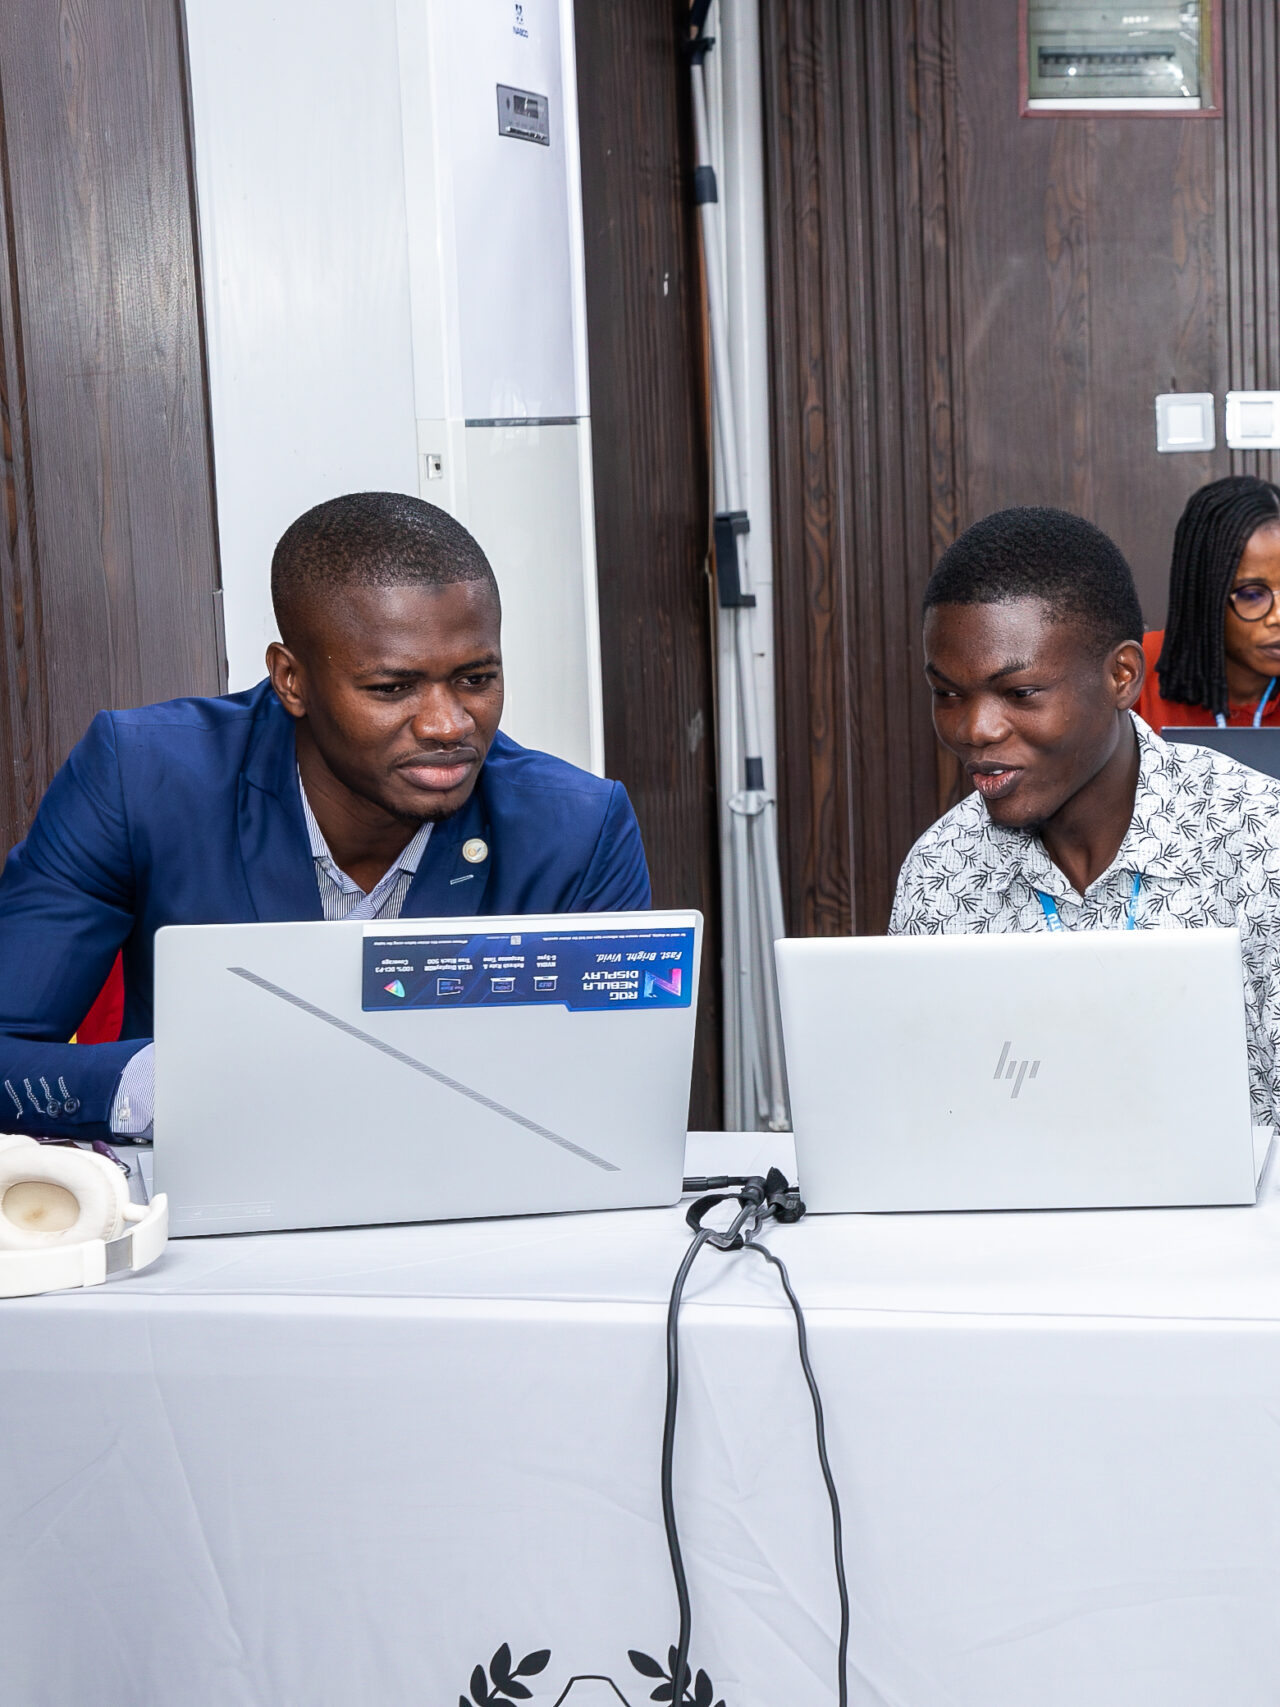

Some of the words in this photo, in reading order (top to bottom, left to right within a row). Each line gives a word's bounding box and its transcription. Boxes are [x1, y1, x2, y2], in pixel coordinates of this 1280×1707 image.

[596, 953, 622, 963] Vivid.
[626, 951, 657, 962] Bright.
[660, 951, 682, 961] Fast.
[581, 970, 639, 980] DISPLAY
[583, 981, 639, 990] NEBULA
[609, 991, 639, 1000] ROG
[993, 1041, 1041, 1099] hp
